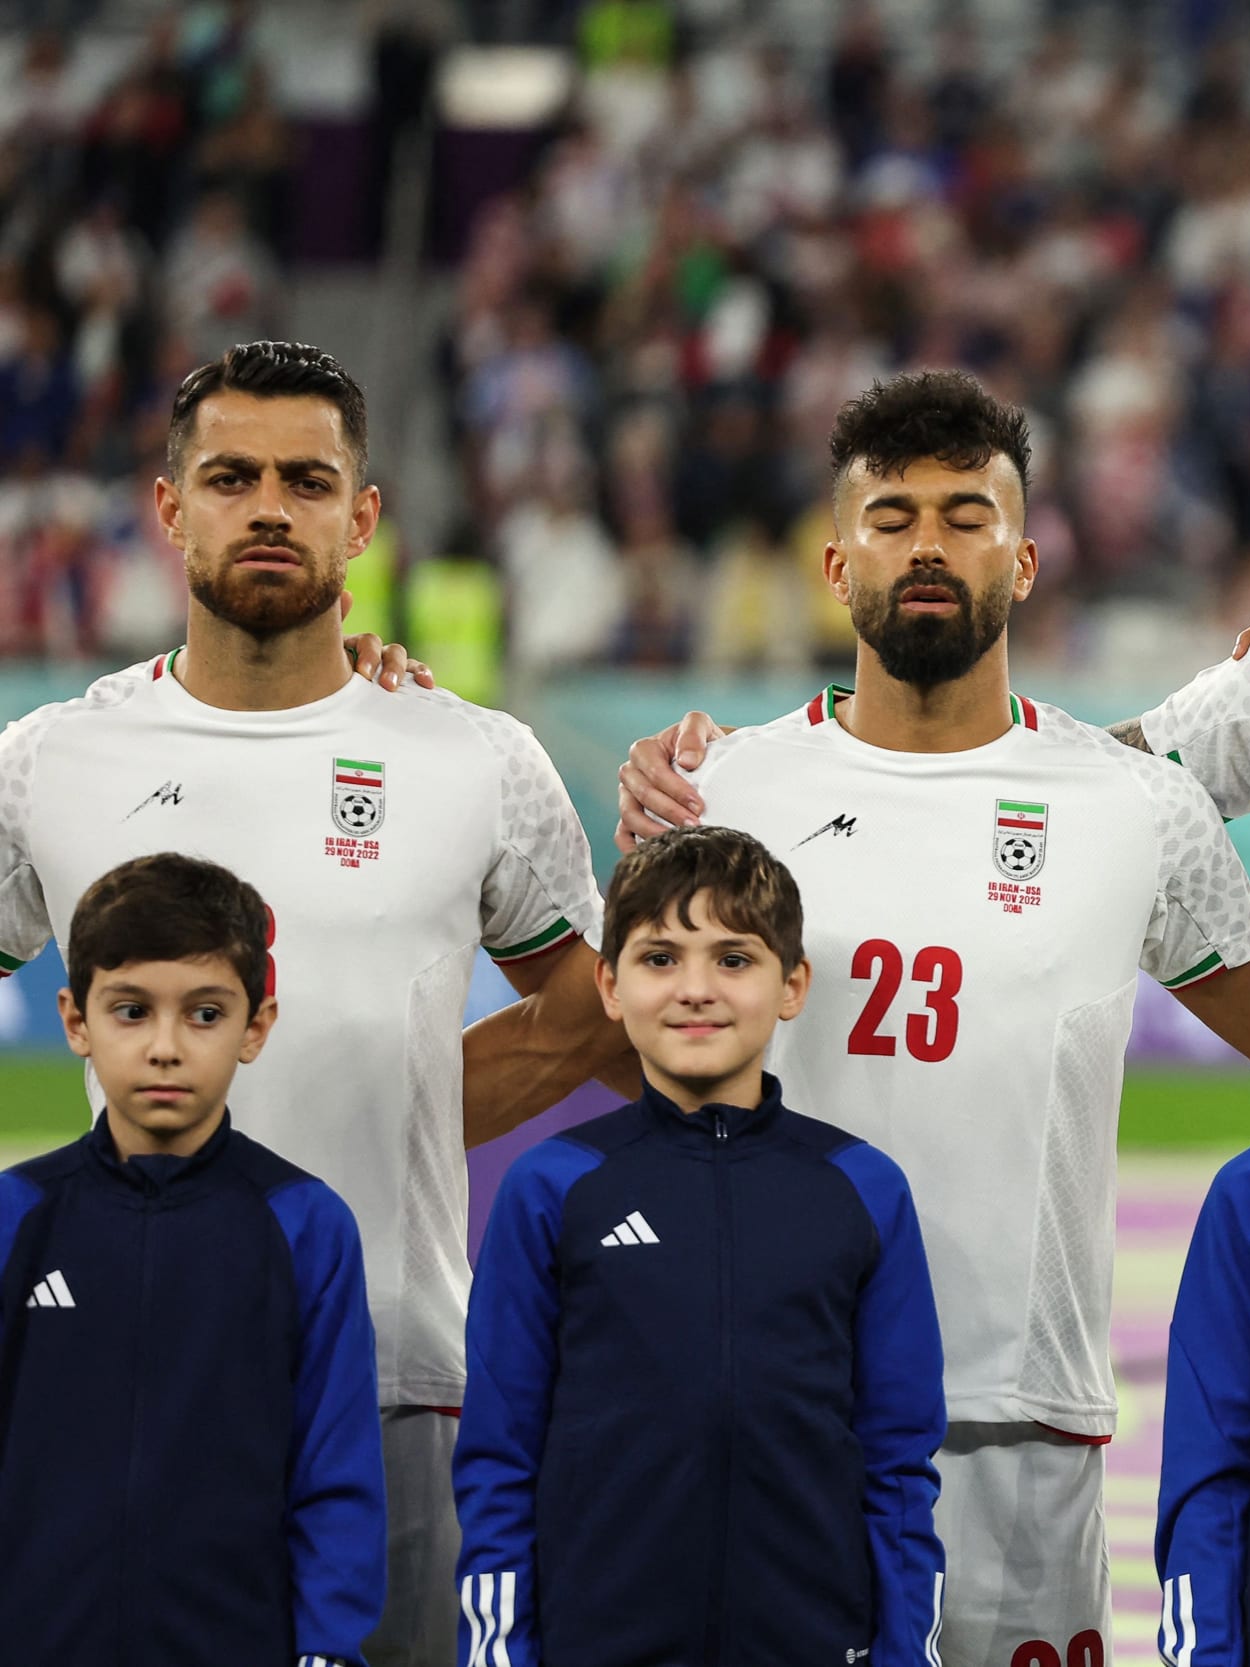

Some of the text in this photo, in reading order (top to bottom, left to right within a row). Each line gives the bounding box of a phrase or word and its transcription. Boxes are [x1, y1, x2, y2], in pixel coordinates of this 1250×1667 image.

[325, 846, 379, 860] 29 NOV 2022
[988, 882, 997, 891] IR
[988, 891, 1041, 906] 29 NOV 2022
[847, 938, 963, 1063] 23
